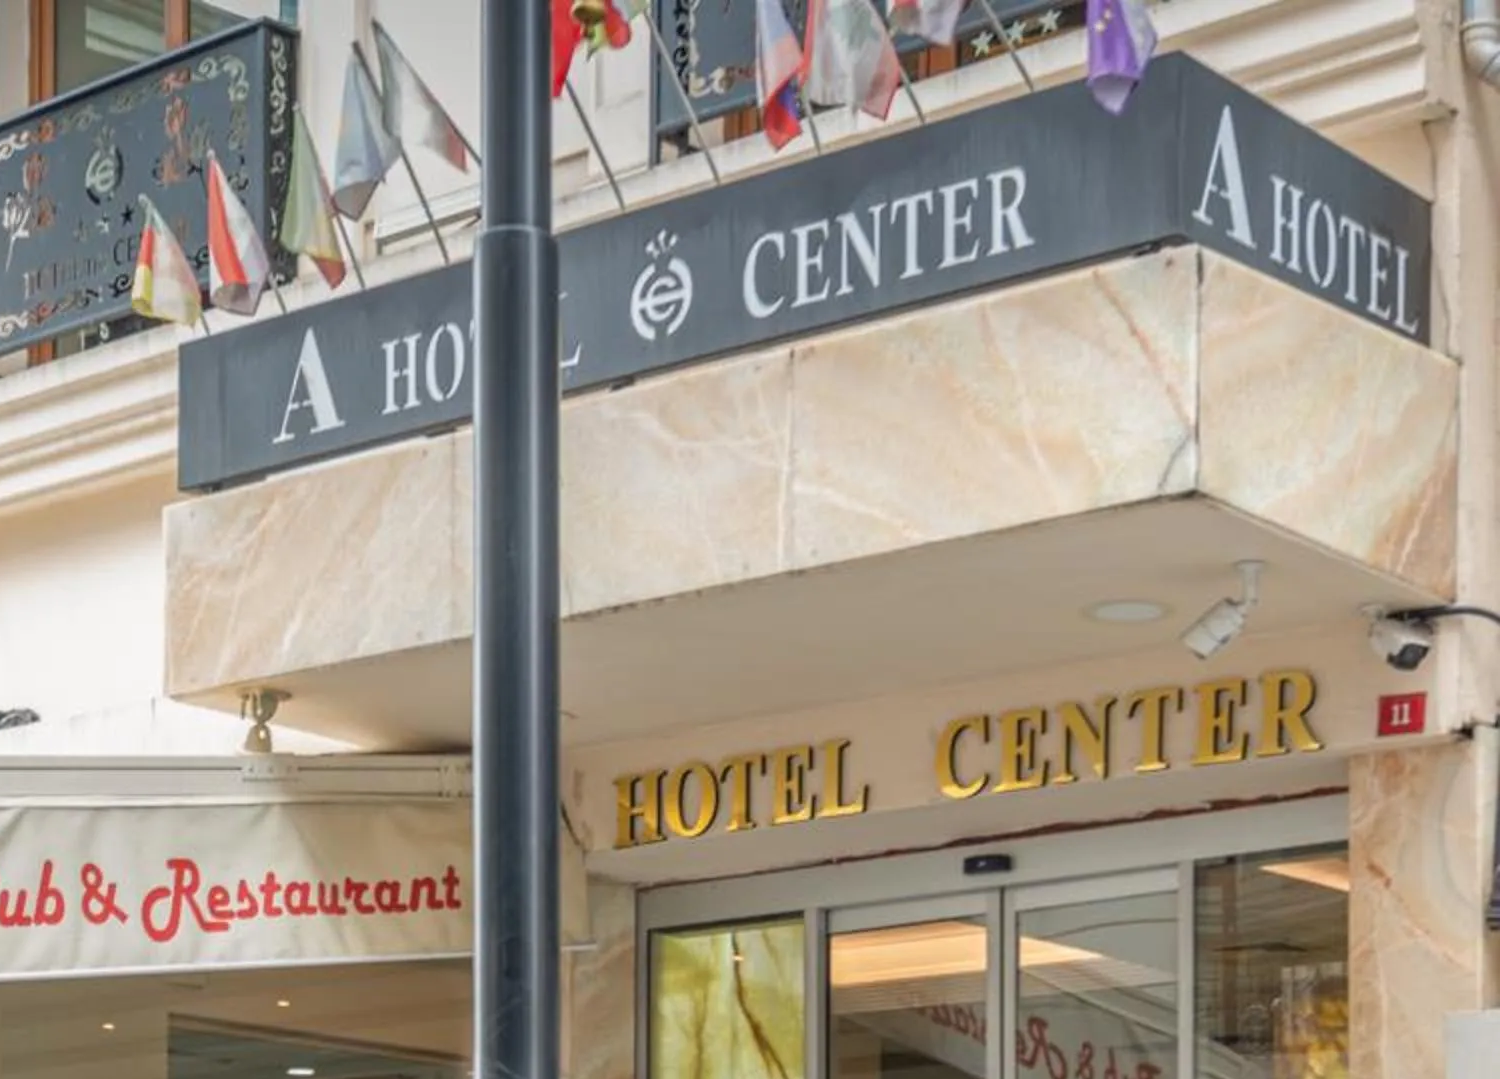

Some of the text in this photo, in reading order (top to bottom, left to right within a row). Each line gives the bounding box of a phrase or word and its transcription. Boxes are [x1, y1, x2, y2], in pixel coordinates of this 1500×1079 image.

[272, 326, 346, 445] A
[742, 165, 1036, 320] CENTER
[1191, 103, 1420, 335] A HOTEL
[612, 666, 1327, 850] HOTEL CENTER
[1389, 702, 1412, 727] 11
[80, 862, 129, 926] &
[140, 856, 463, 944] Restaurant
